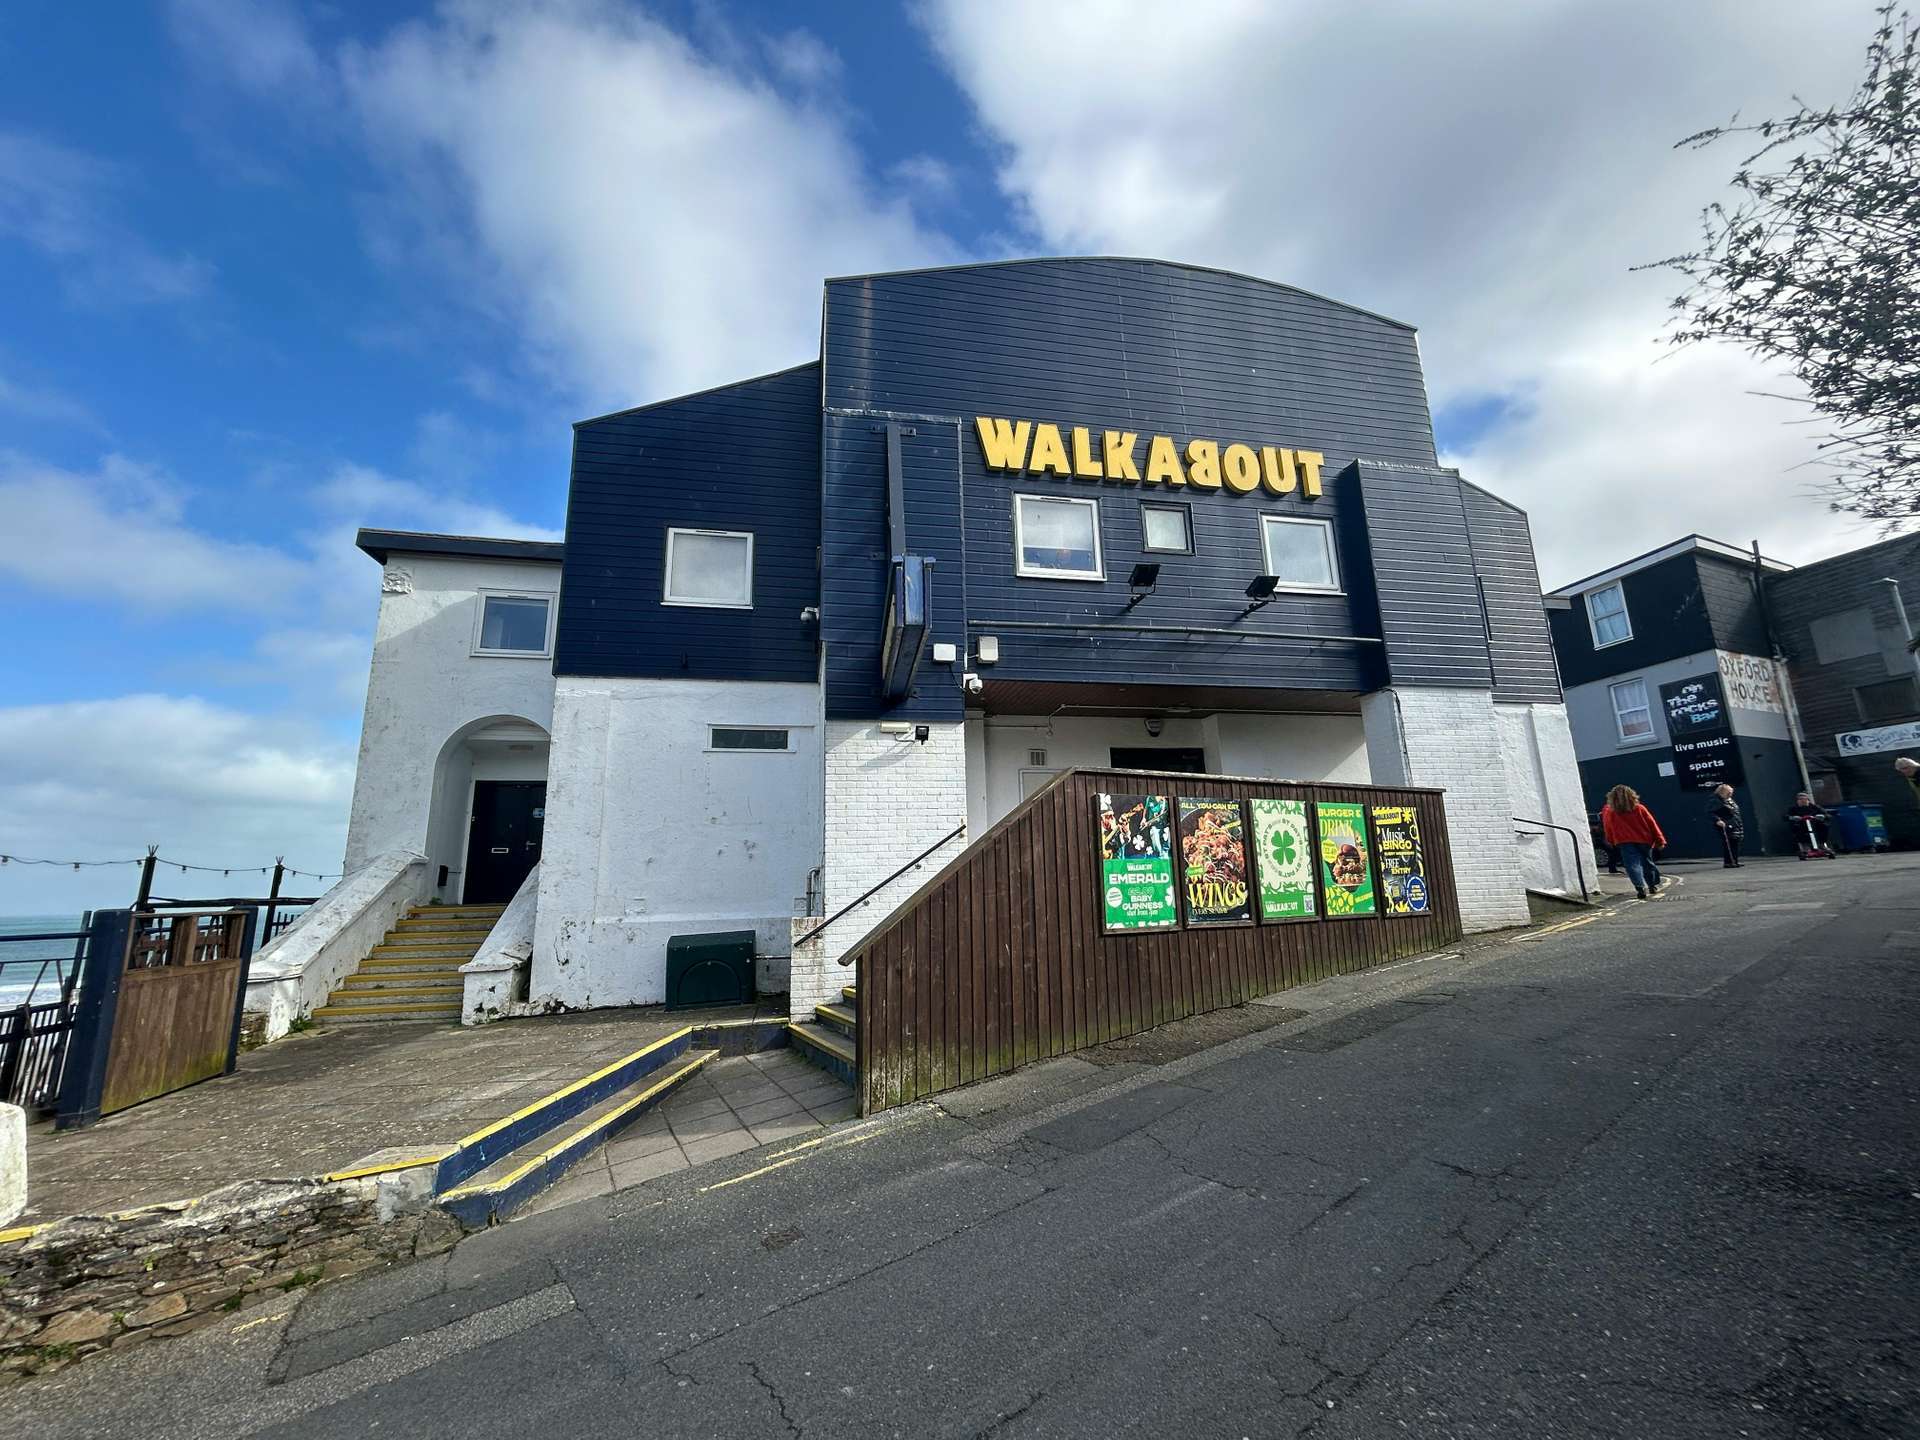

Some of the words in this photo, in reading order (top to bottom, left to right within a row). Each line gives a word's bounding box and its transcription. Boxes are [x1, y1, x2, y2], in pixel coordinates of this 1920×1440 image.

[975, 416, 1325, 499] WALKABOUT
[1719, 656, 1770, 682] OXFORD
[1675, 741, 1696, 752] live
[1697, 736, 1729, 749] music
[1689, 758, 1725, 771] sports
[1318, 808, 1355, 817] BURGER
[1320, 819, 1354, 837] DRINK
[1381, 827, 1406, 842] Music
[1382, 840, 1412, 850] BINGO
[1386, 858, 1400, 869] FREE
[1391, 867, 1412, 876] ENTRY
[1109, 873, 1169, 885] EMERALD
[1131, 895, 1152, 903] BABY
[1188, 881, 1248, 908] WINGS
[1122, 902, 1163, 910] GUINNESS
[1266, 902, 1298, 912] WALKABOUT
